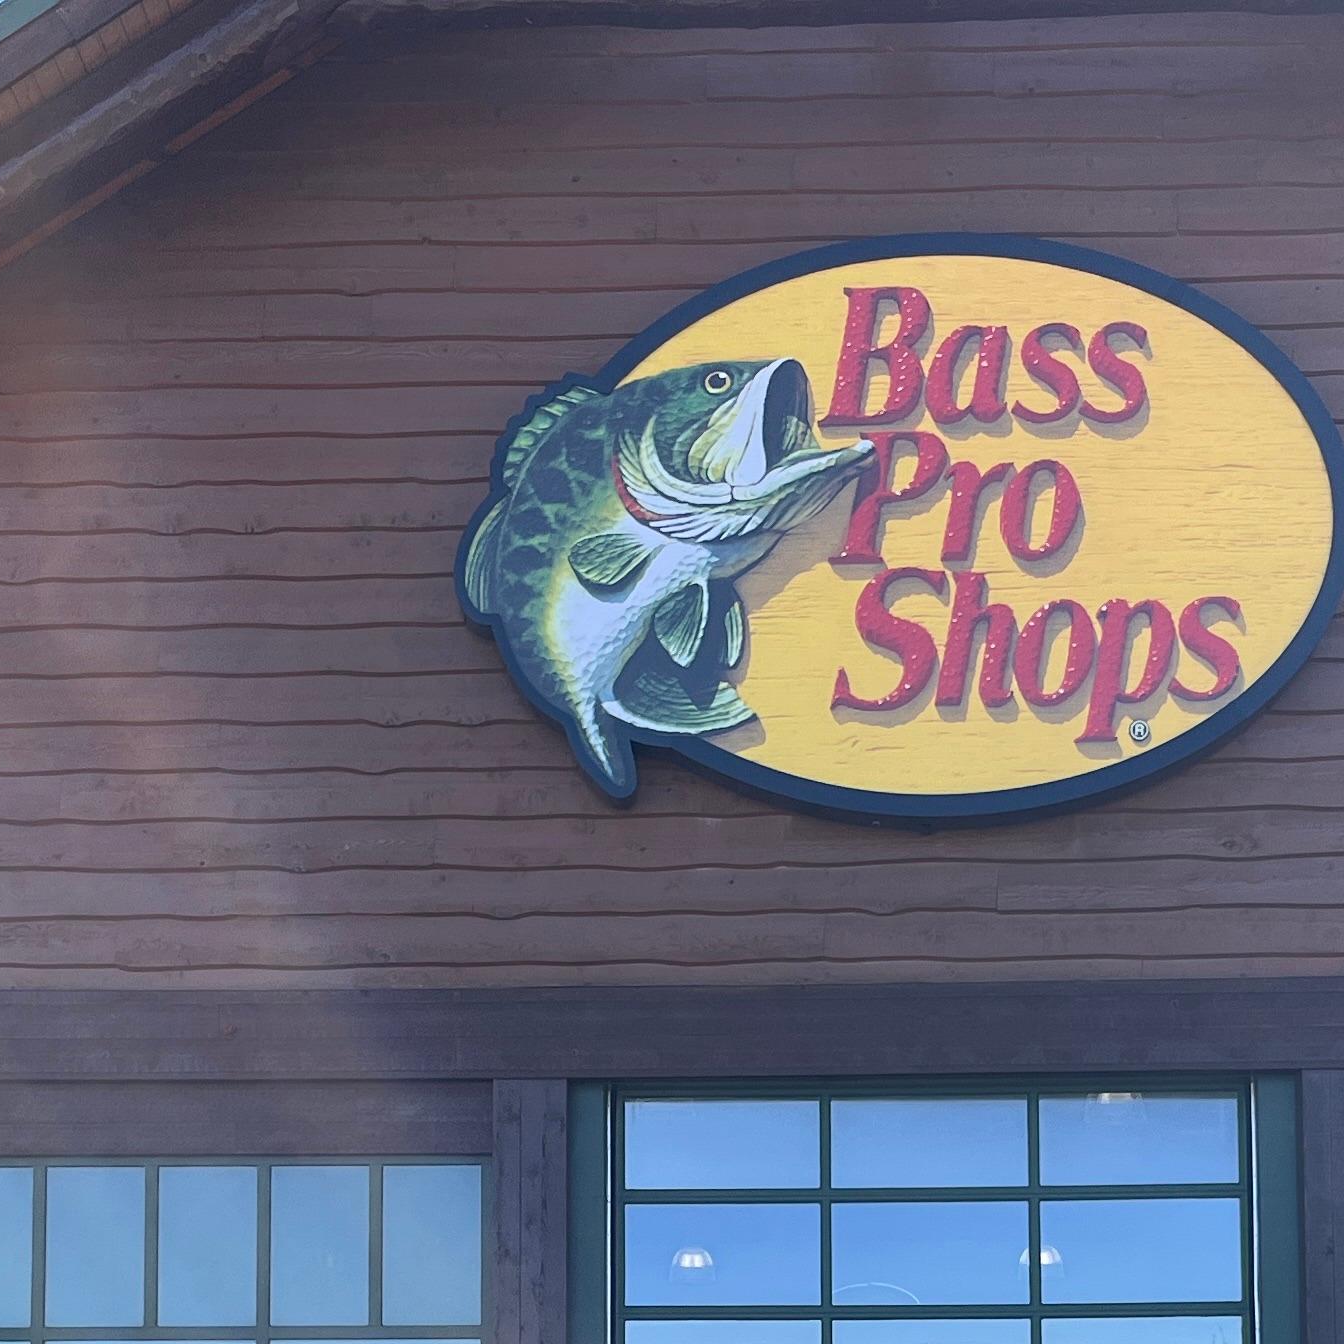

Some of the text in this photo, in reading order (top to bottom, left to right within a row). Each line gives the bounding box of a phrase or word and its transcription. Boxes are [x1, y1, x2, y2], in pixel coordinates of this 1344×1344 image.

[820, 286, 1151, 429] Bass
[829, 430, 1082, 565] Pro
[831, 567, 1241, 744] Shops
